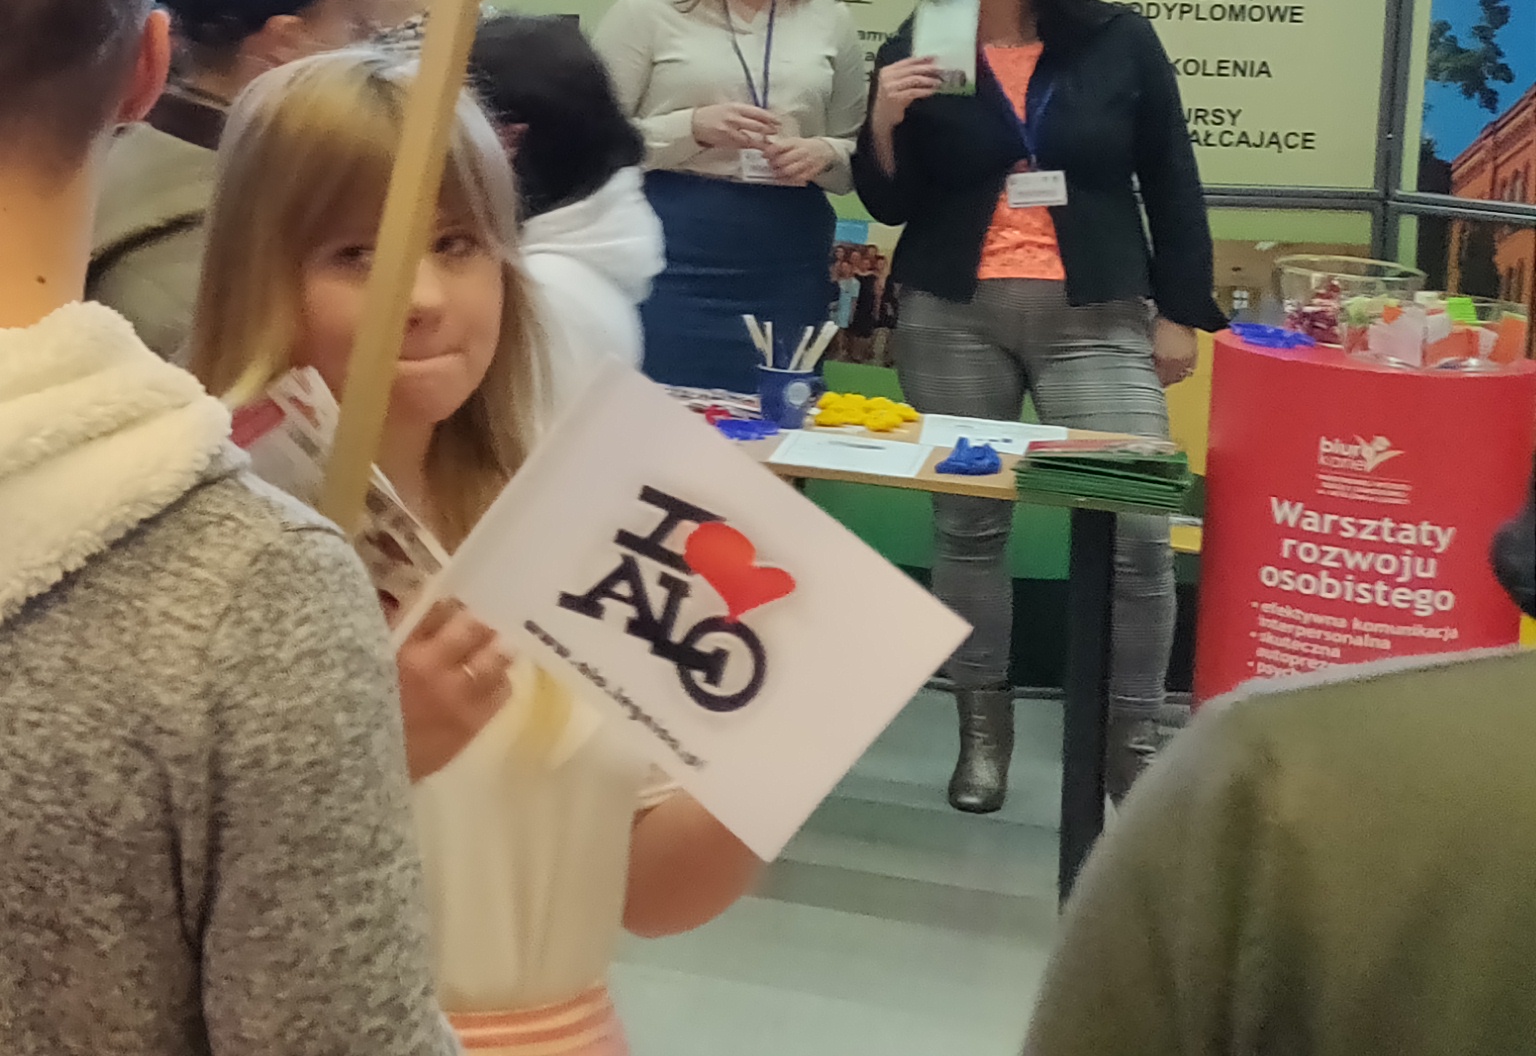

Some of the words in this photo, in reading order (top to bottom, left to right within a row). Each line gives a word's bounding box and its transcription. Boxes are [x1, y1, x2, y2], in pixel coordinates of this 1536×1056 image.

[1189, 130, 1317, 153] AŁCAJĄCE
[1270, 496, 1456, 553] Warsztaty
[1282, 538, 1438, 583] rozwoju
[1260, 566, 1455, 617] osobistego
[1352, 618, 1459, 642] komunikacja
